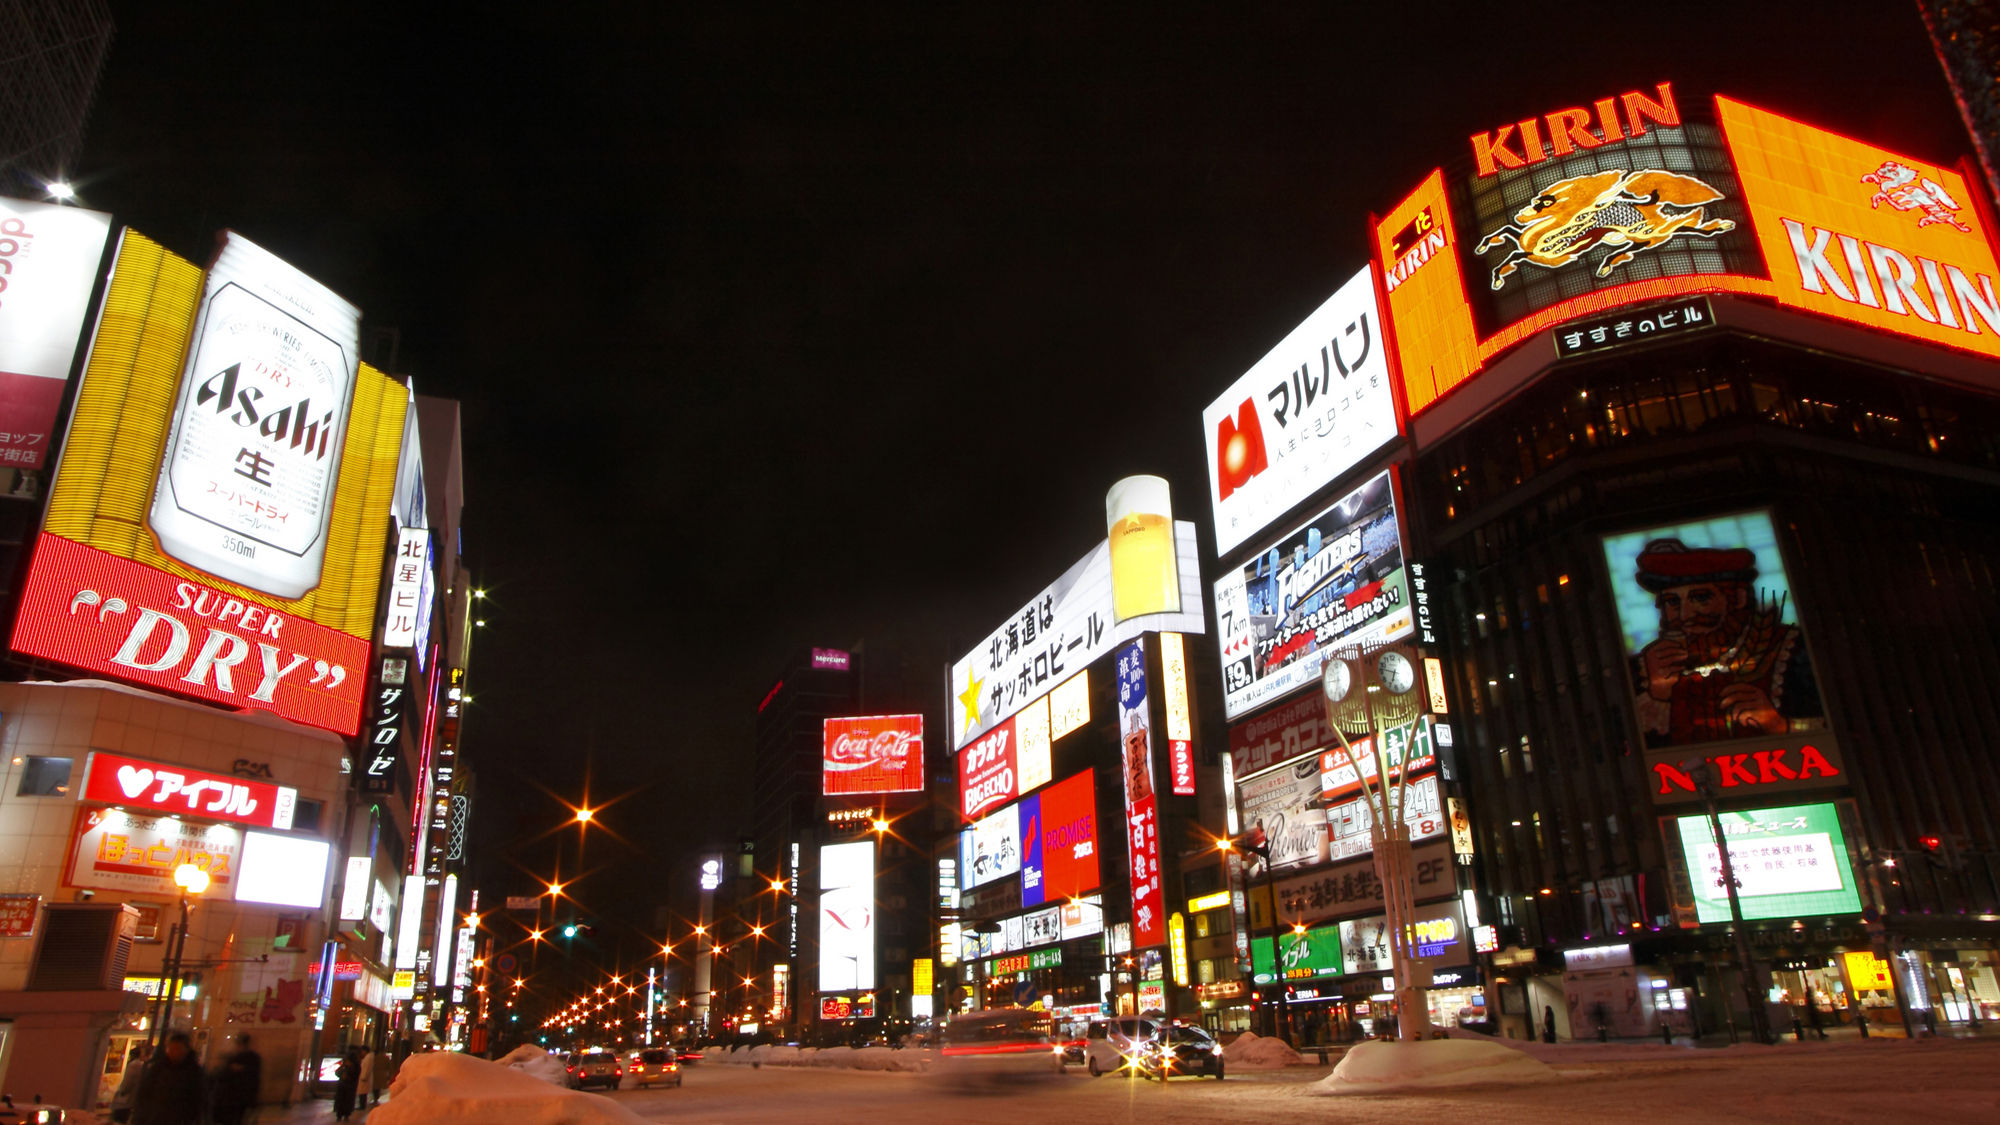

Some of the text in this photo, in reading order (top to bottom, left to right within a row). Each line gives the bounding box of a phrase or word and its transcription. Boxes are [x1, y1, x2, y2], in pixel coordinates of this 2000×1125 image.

[1471, 81, 1681, 177] KIRIN
[1385, 226, 1449, 293] KIRIN
[1780, 217, 2000, 339] KIRIN
[1564, 306, 1703, 351] すすきのビル
[1268, 312, 1370, 430] マルハン
[197, 362, 334, 462] Asahi
[1275, 373, 1379, 462] 人生にヨロコビを
[0, 448, 38, 463] 街店
[233, 447, 275, 488] 生
[206, 480, 290, 524] スーパードライ
[222, 535, 257, 559] 350ml
[1122, 526, 1146, 537] SAPPORO
[391, 540, 423, 633] 北星ビル
[1275, 527, 1364, 631] FIGHTERS
[170, 582, 284, 640] SUPER
[1411, 563, 1435, 643] すすきのビル
[989, 594, 1054, 672] 北海道は
[1258, 597, 1347, 657] ファイターズを見ずに
[815, 655, 846, 664] Mercure
[990, 610, 1105, 717] サッポロビール
[1118, 656, 1132, 703] 革命
[831, 730, 911, 760] Coca-Cola
[966, 730, 1009, 775] カラオケ
[1175, 741, 1190, 786] カラオケ
[1653, 744, 1839, 795] NKKA
[153, 770, 257, 817] アイフル
[95, 831, 231, 875] ほっとハウス
[1046, 815, 1092, 854] PROMISE
[1146, 806, 1159, 890] 本格麦焼酎
[1340, 840, 1363, 855] Media
[1707, 843, 1815, 861] 邦救出で武器使用基
[1416, 857, 1444, 886] 2F
[1457, 853, 1474, 866] 4F
[1709, 857, 1818, 874] 準和を 自民・石破
[1425, 945, 1446, 957] STORE
[1573, 953, 1591, 963] LARK
[1707, 926, 1859, 950] SUUKINO BLD.
[333, 963, 362, 974] たばこ
